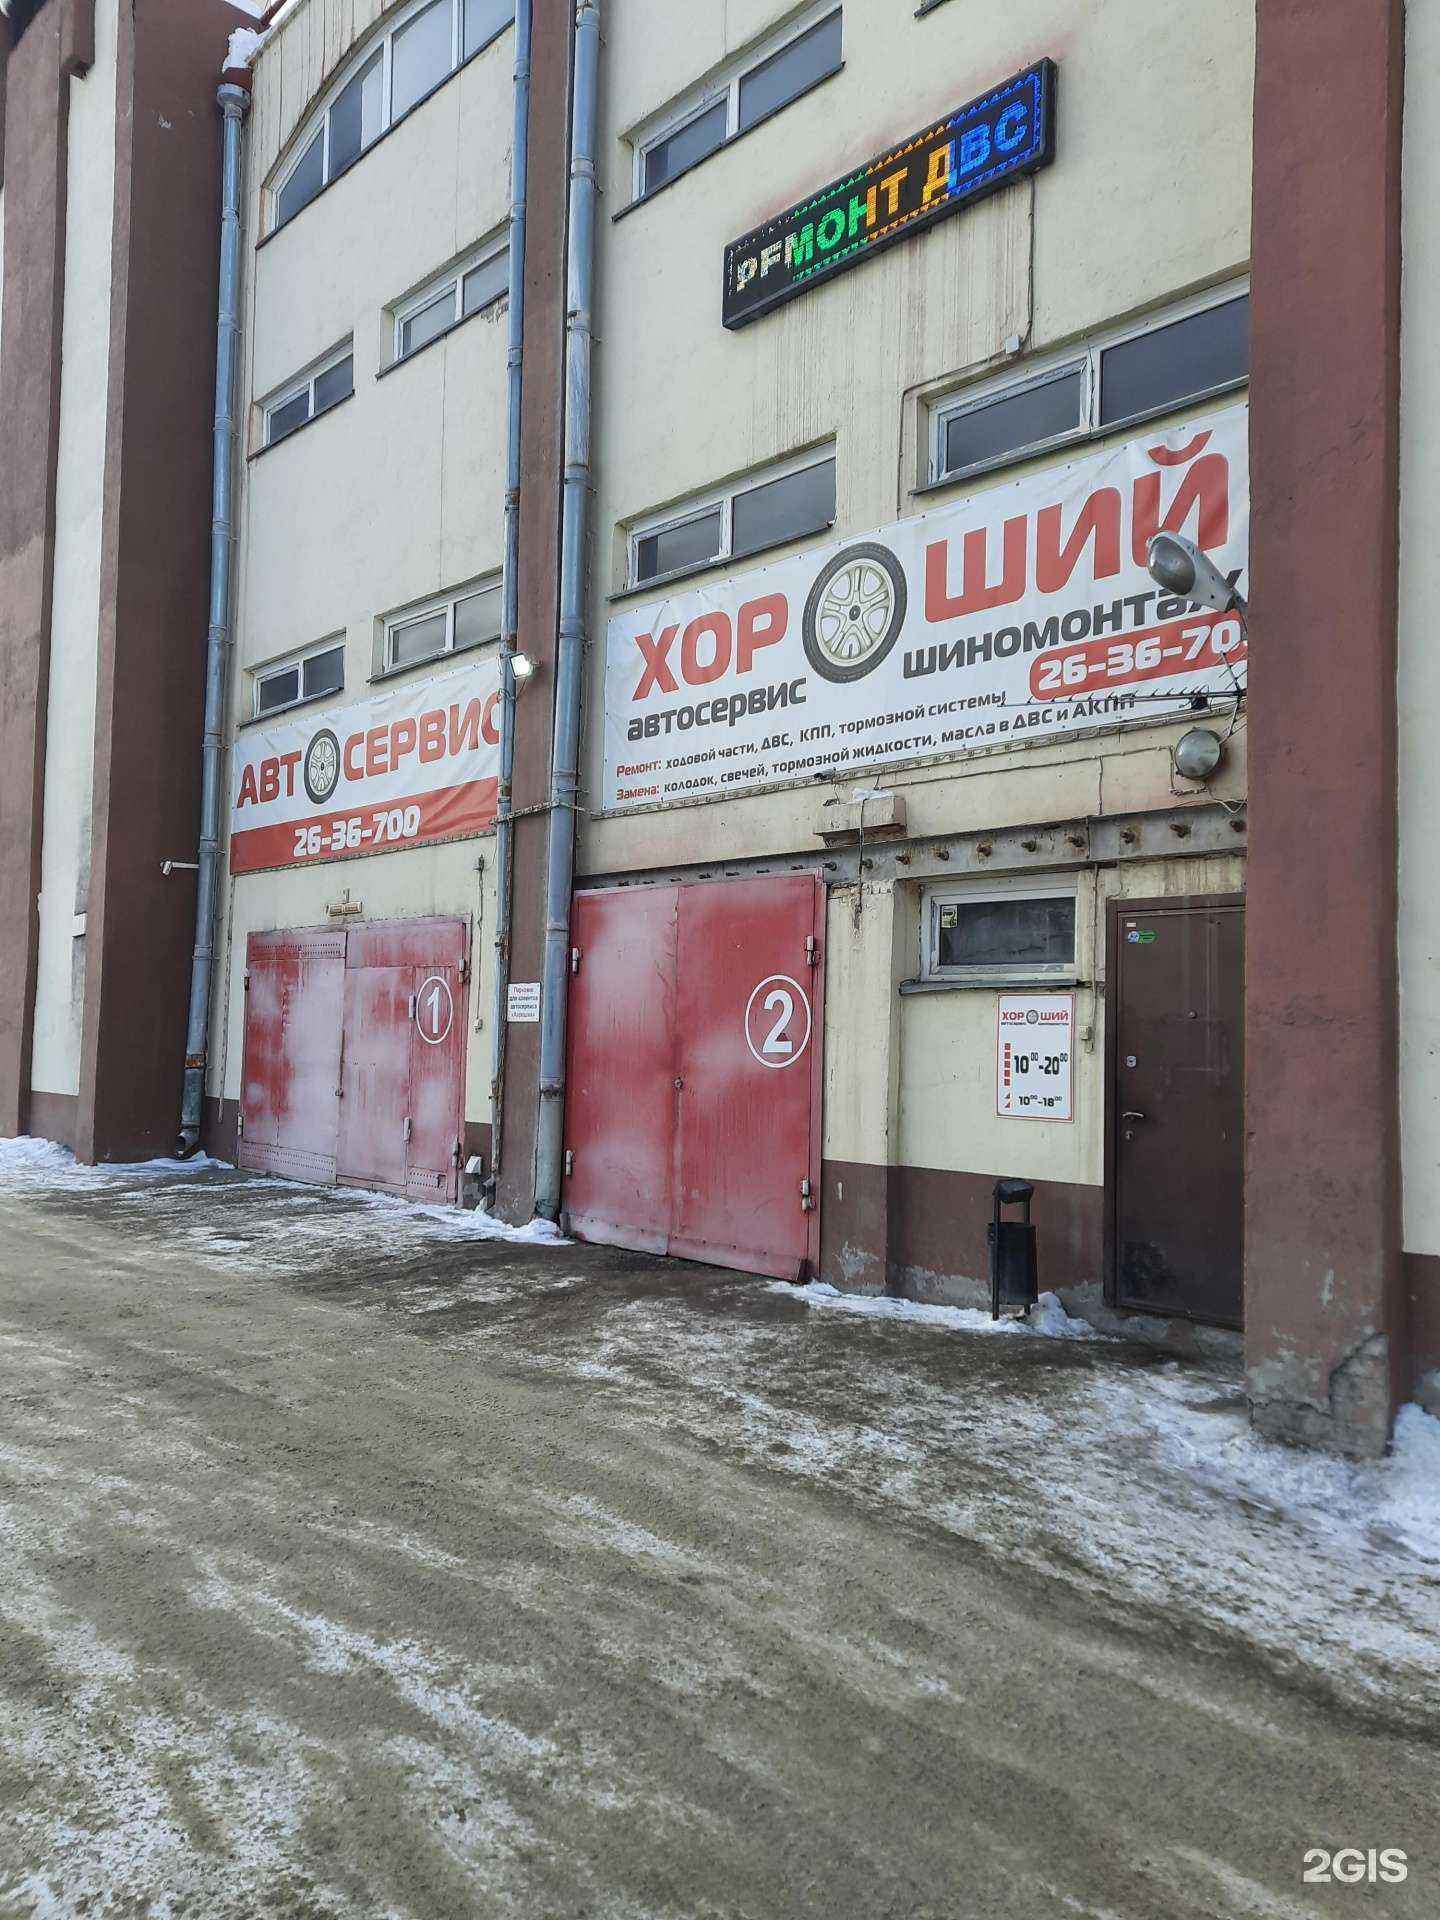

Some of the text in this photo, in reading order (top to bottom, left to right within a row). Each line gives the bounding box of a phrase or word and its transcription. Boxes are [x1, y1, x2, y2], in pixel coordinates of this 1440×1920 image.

[922, 100, 1028, 204] ДВС
[632, 429, 1230, 702] ХОР ШИЙ
[616, 690, 1006, 778] Ремонт: ходовой части, ДВС, КПП, тормозной системы
[627, 677, 807, 742] автосервис
[616, 692, 1136, 801] Замена: колодок, свечей, тормозной жидкости, масла в ДВС и АКПП
[237, 750, 302, 808] АВТ
[292, 804, 422, 858] 26-36-700
[426, 986, 440, 1034] 1
[762, 989, 794, 1053] 2
[1002, 1011, 1025, 1021] ХОР
